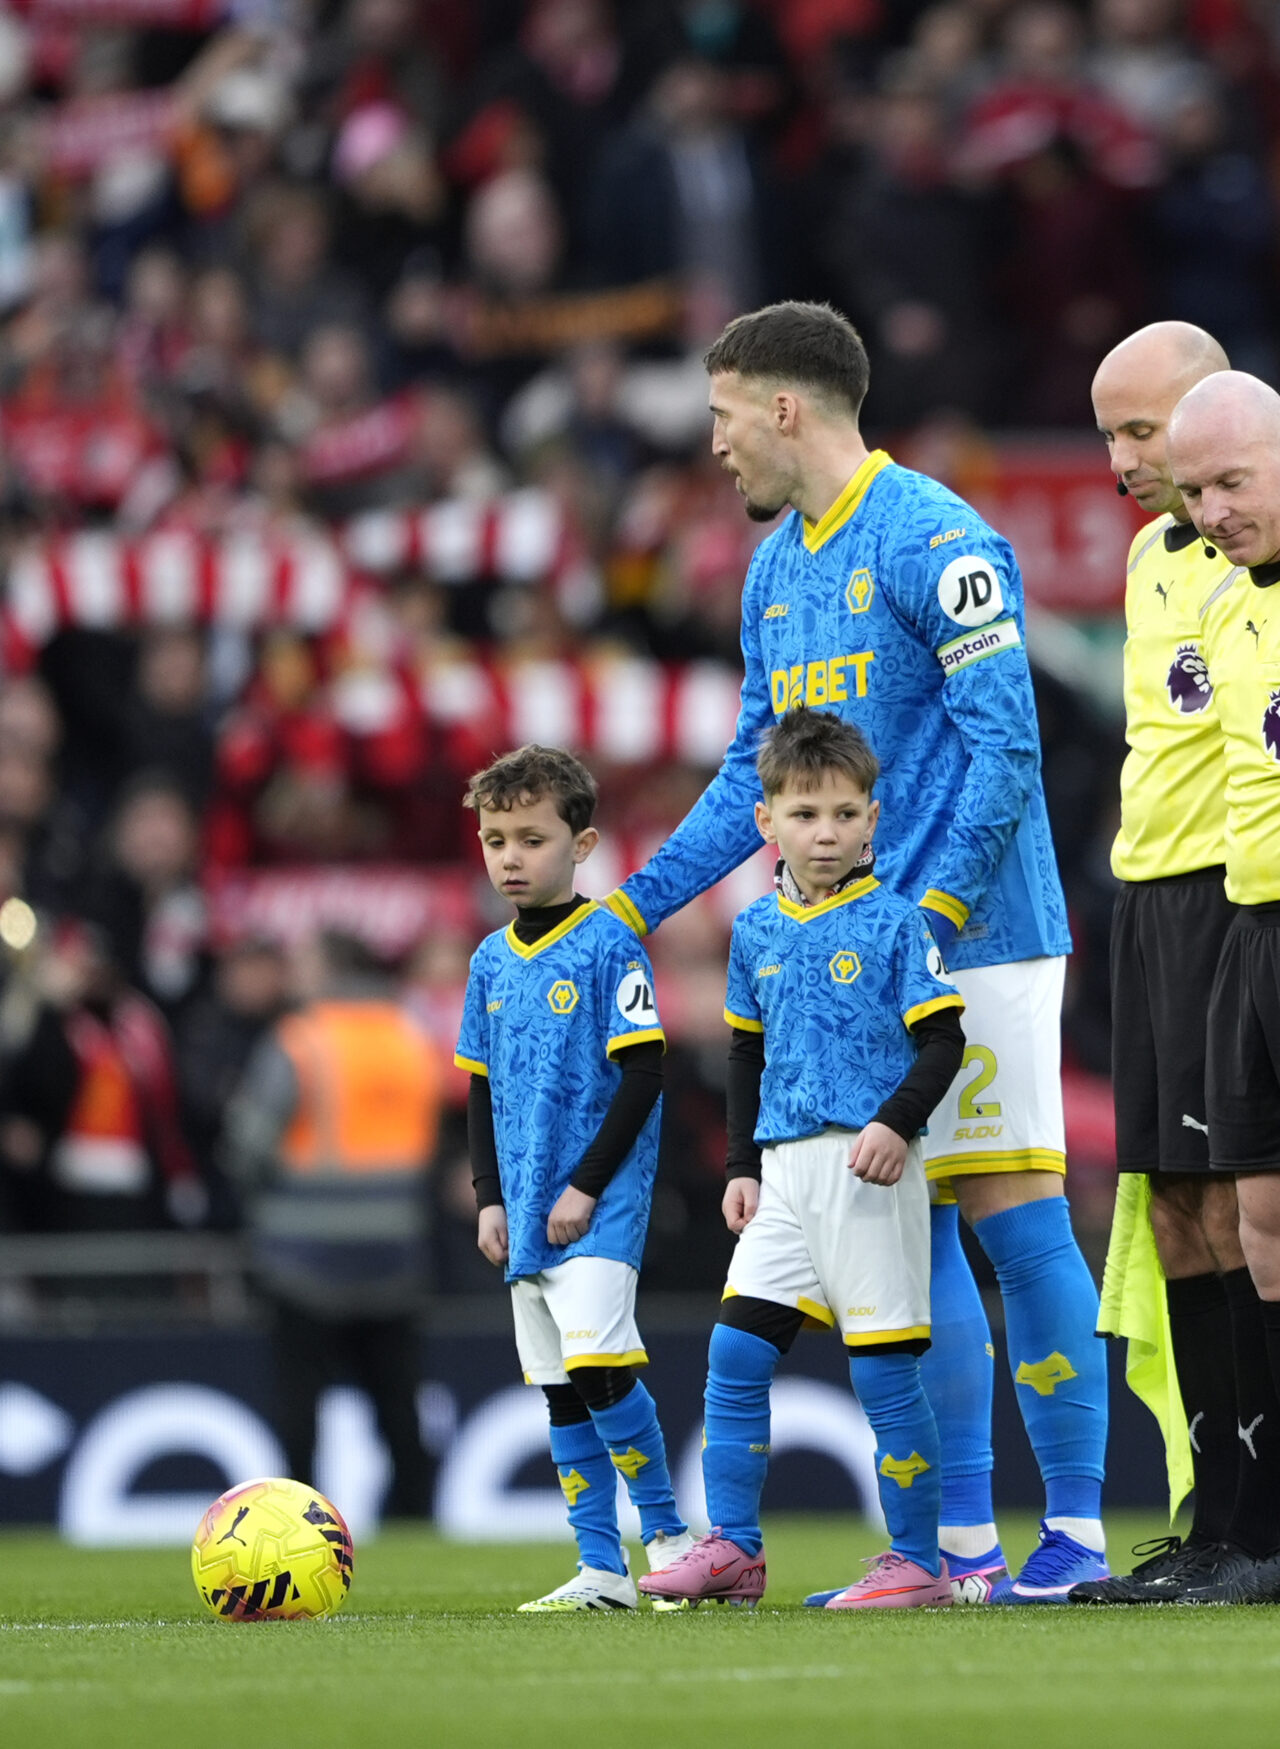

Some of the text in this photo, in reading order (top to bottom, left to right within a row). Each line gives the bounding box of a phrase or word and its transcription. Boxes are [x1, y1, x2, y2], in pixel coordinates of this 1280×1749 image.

[930, 528, 966, 550] SUDU
[953, 570, 992, 616] JD
[771, 651, 875, 715] DEBET
[936, 955, 950, 976] J
[958, 1044, 1001, 1119] 2
[952, 1124, 1004, 1141] SUDU
